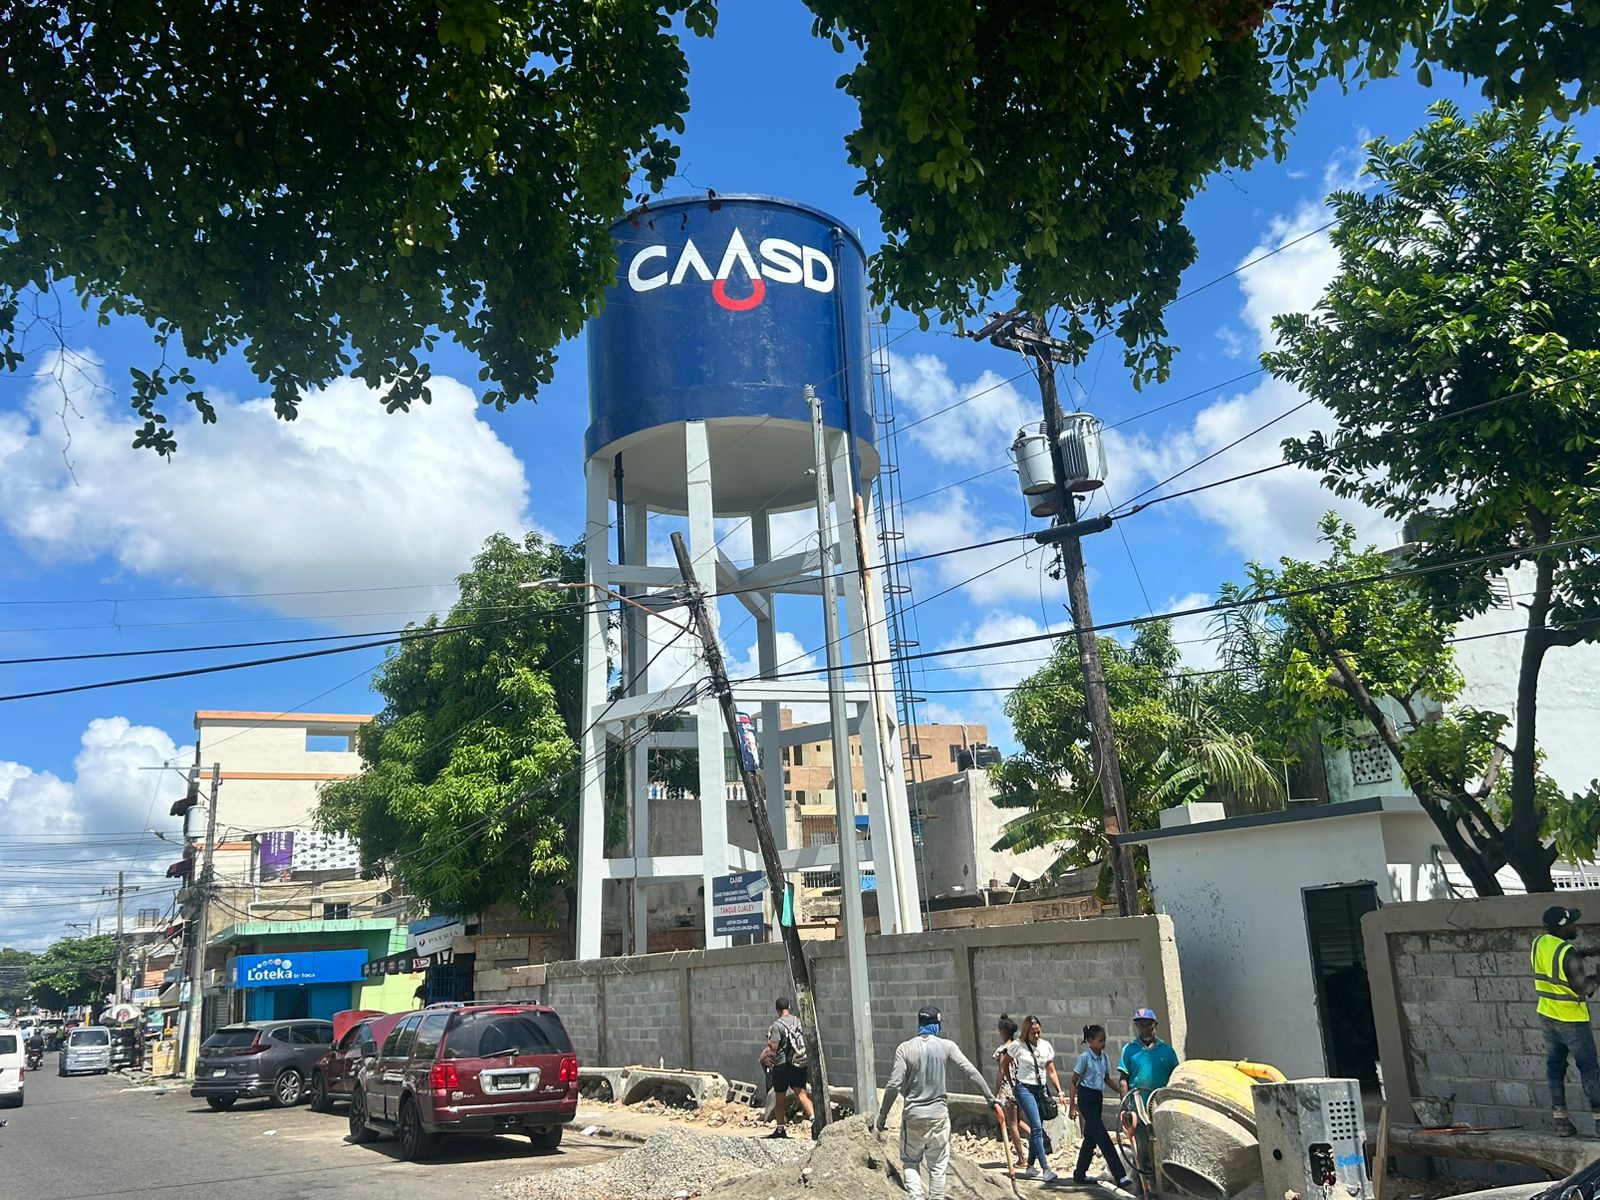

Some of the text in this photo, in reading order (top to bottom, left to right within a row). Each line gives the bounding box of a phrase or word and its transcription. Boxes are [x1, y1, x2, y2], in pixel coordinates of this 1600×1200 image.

[628, 226, 835, 294] CAASD
[428, 931, 459, 944] PATRIA
[247, 967, 293, 981] Loteka
